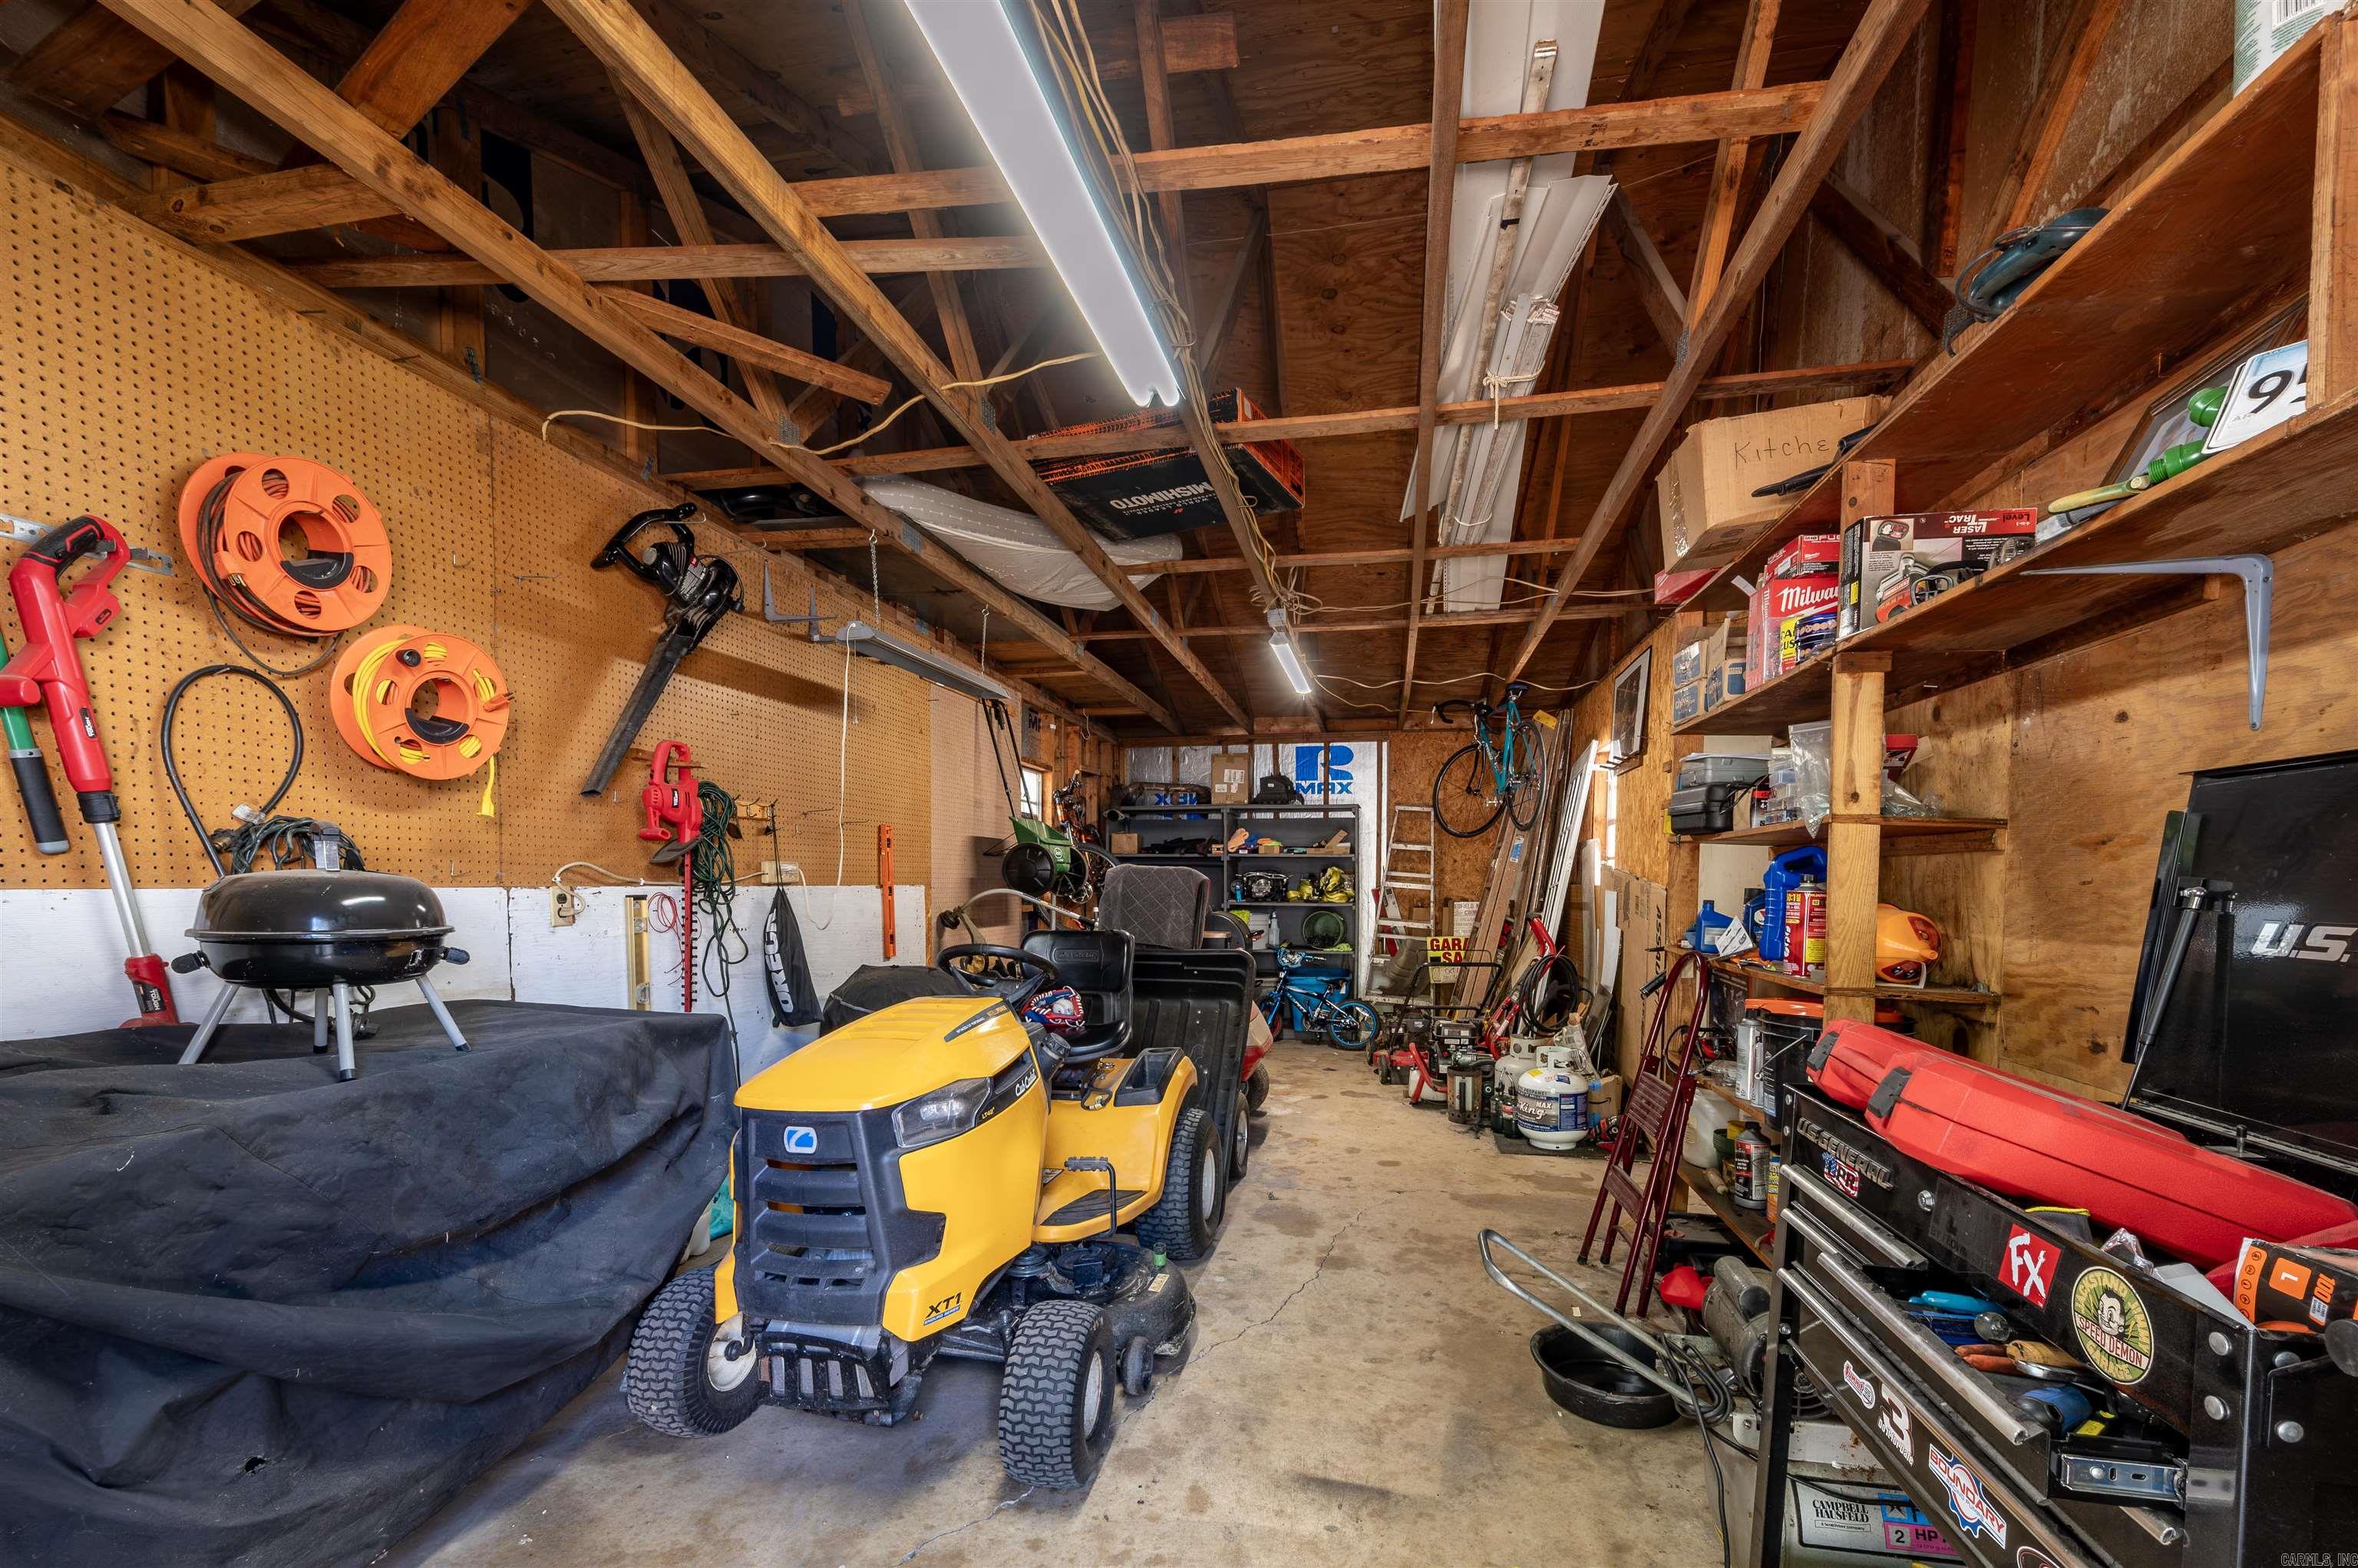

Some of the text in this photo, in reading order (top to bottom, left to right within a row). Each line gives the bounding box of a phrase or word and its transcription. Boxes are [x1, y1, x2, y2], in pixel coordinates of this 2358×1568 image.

[1109, 481, 1214, 509] MISHIMOTO
[1949, 514, 1977, 526] TRAC
[1953, 513, 2030, 534] Level LASER
[765, 908, 794, 1013] ORECK
[1653, 904, 1663, 999] ASSAUT
[1535, 1101, 1553, 1109] MAX
[2008, 1231, 2046, 1299] FX
[2313, 1273, 2336, 1304] 100
[925, 1292, 962, 1319] XT1
[2079, 1316, 2143, 1368] SPEED DEMON
[1930, 1448, 2005, 1533] BOUNDARY
[1812, 1499, 1869, 1515] CAMPBELL
[1815, 1508, 1870, 1523] HAUSFELD
[1894, 1528, 1939, 1543] 2 HP
